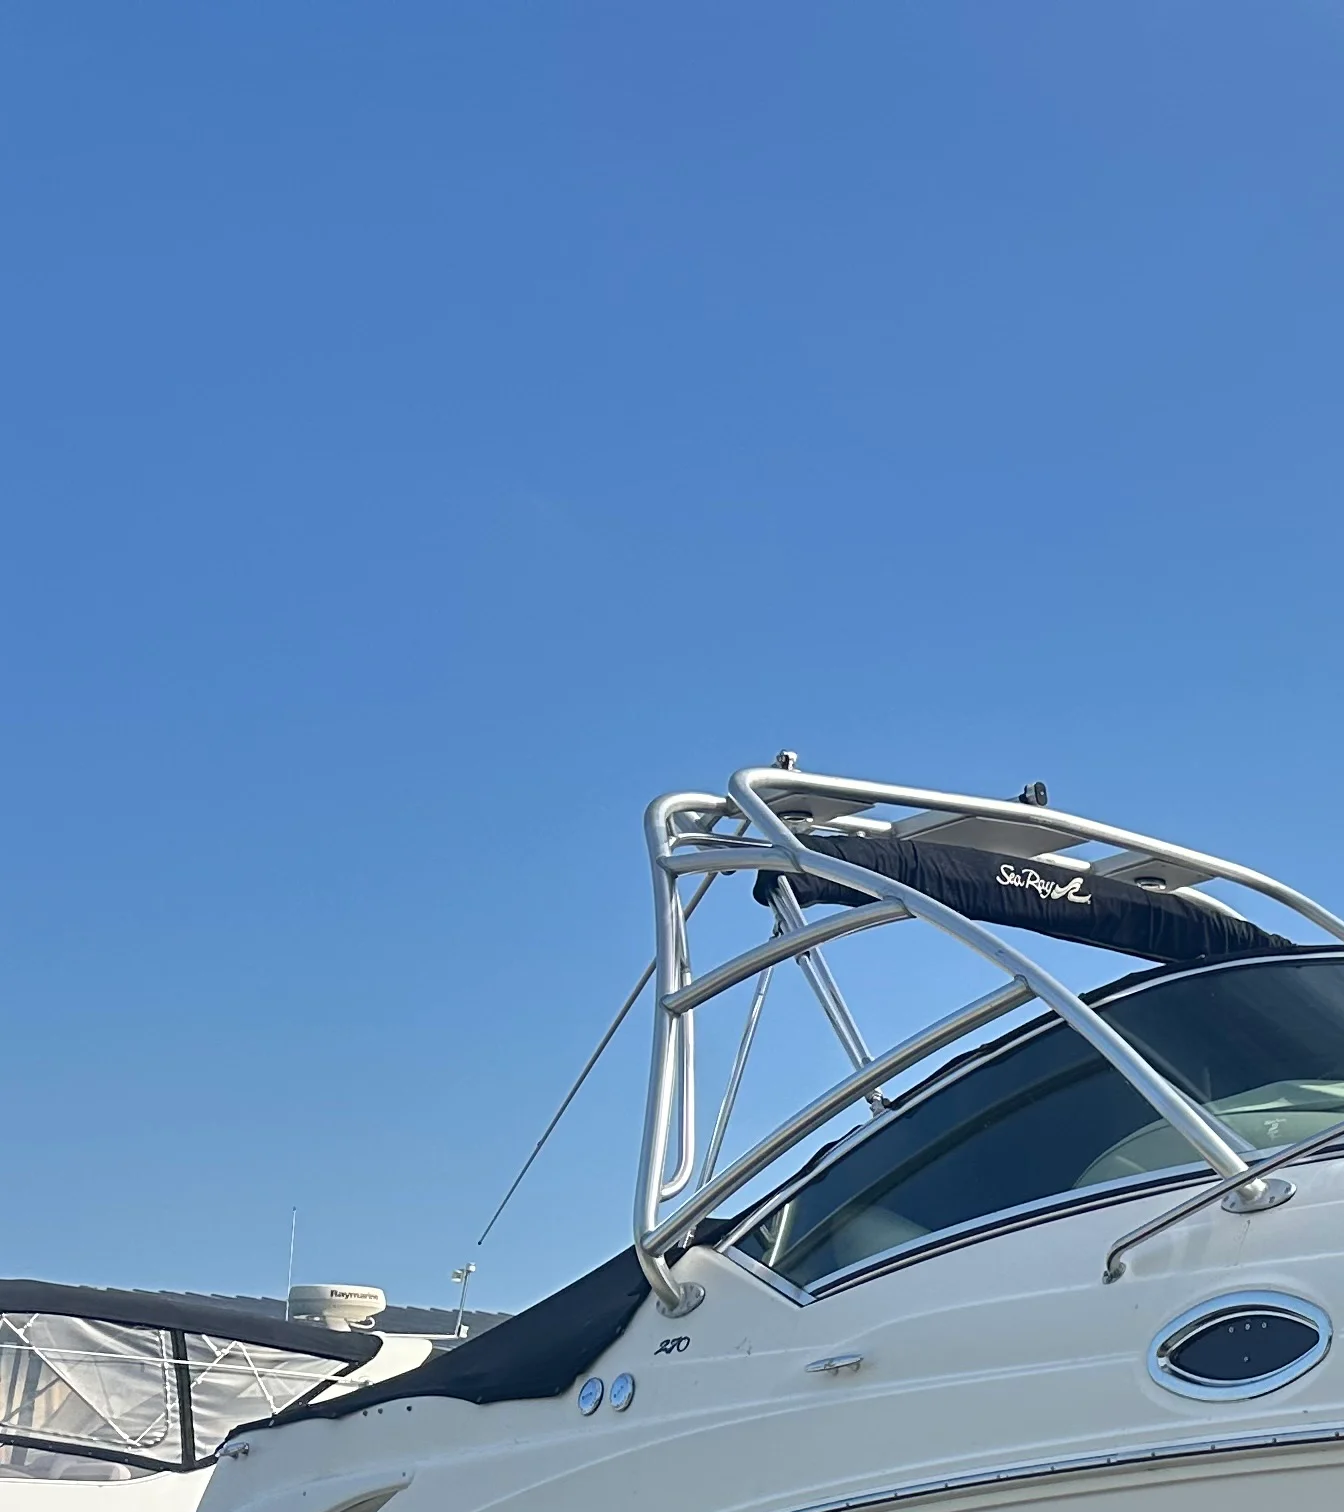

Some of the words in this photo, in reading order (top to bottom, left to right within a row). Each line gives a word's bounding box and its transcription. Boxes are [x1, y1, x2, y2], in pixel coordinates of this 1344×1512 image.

[996, 864, 1025, 887] Sea
[1021, 868, 1055, 899] Ray
[653, 1336, 691, 1356] 270
